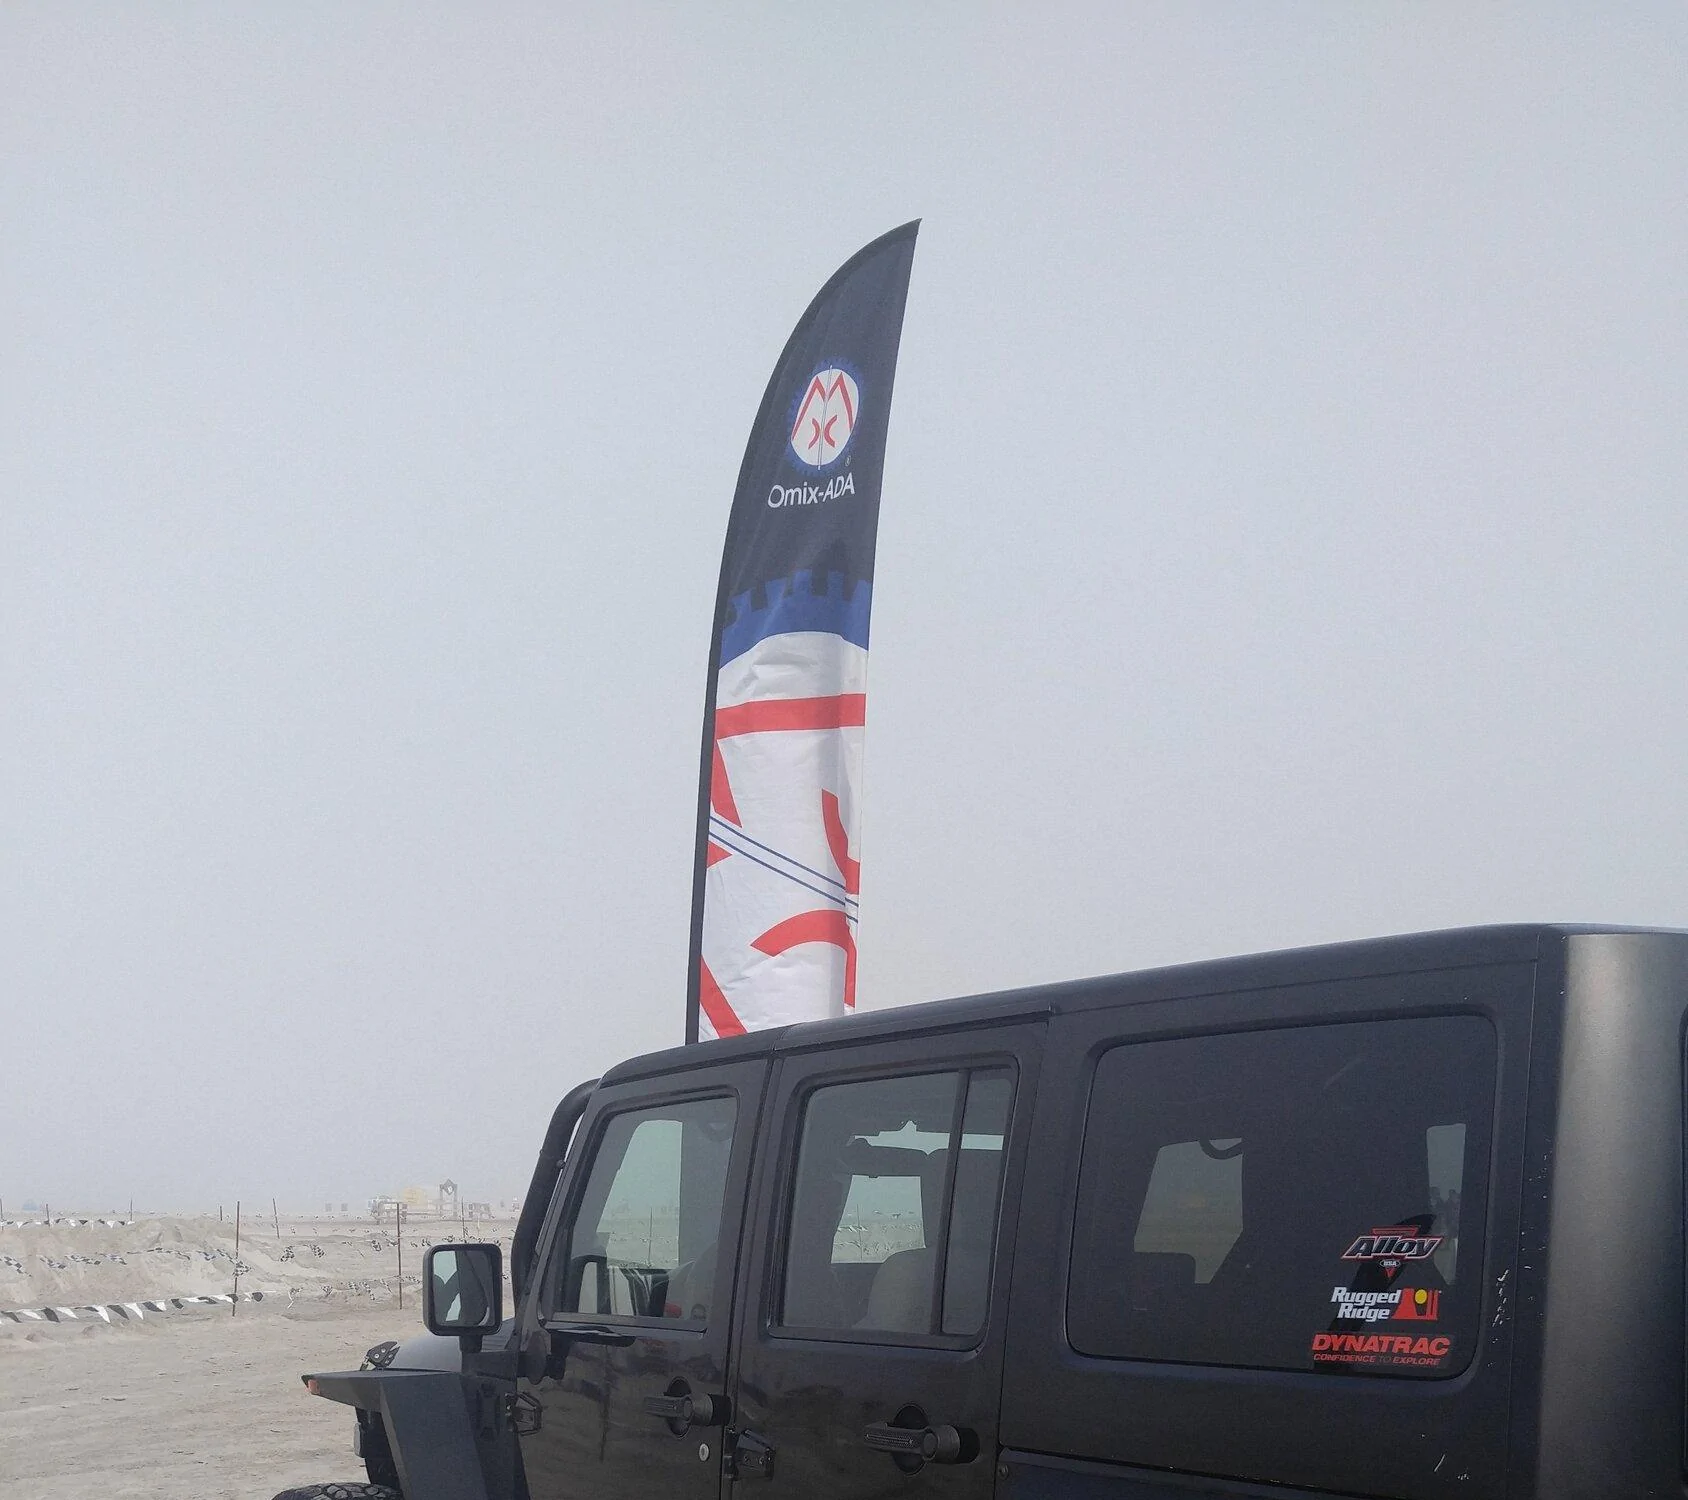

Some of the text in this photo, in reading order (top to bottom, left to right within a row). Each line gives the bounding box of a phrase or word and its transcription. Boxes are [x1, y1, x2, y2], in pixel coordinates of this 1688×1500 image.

[767, 472, 855, 508] Omix-ADA
[1342, 1236, 1442, 1259] Alloy
[1331, 1287, 1401, 1306] Rugged
[1337, 1303, 1390, 1322] Ridge
[1312, 1334, 1450, 1356] DYNATRAC
[1313, 1353, 1441, 1365] CONFIDENCE TO EXPLORE
